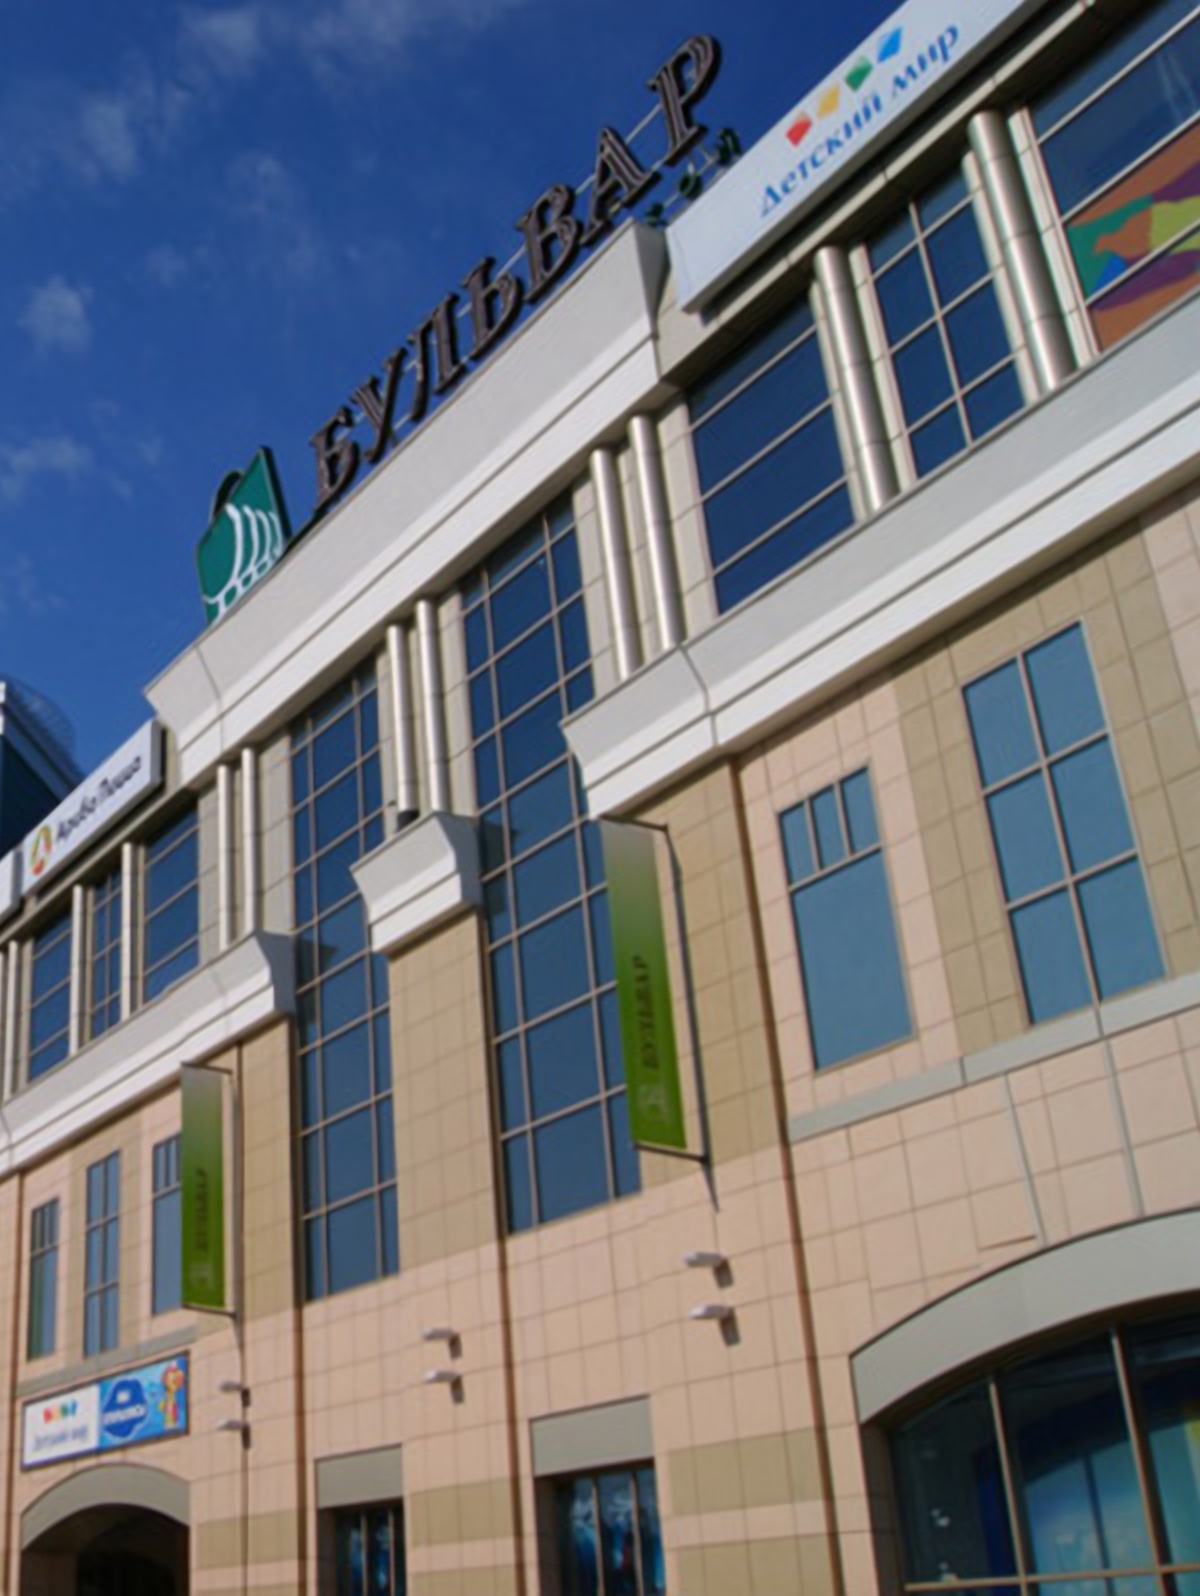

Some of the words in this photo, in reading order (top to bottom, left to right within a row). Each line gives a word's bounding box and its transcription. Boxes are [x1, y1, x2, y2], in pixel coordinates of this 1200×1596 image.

[310, 33, 724, 513] БУЛЬВАР
[759, 93, 883, 219] Детский
[889, 23, 961, 101] мир
